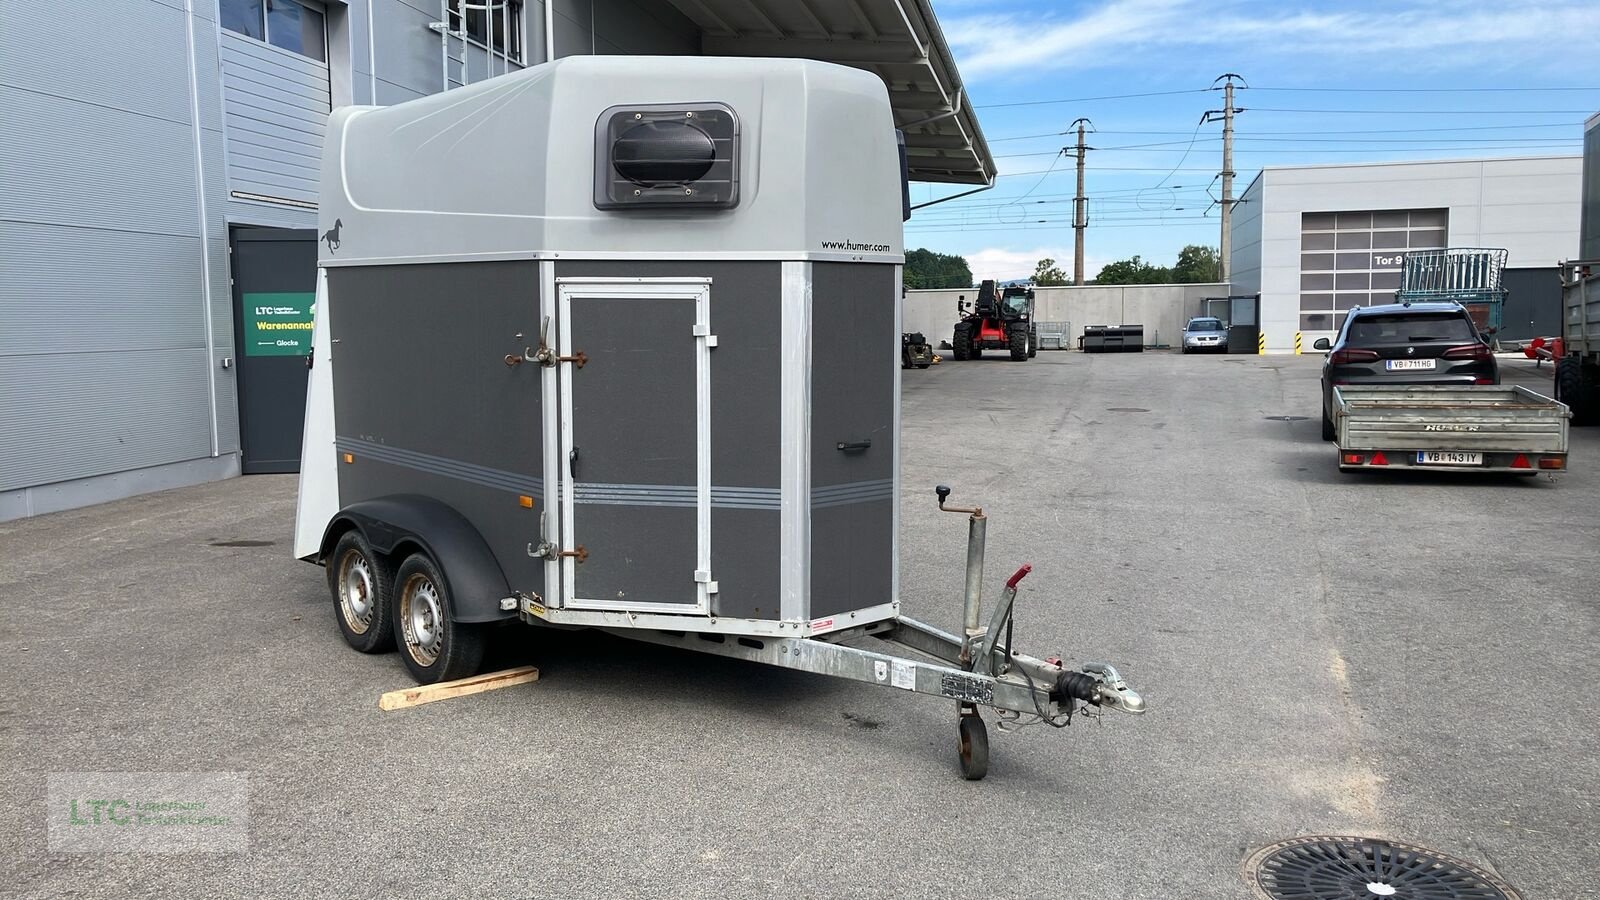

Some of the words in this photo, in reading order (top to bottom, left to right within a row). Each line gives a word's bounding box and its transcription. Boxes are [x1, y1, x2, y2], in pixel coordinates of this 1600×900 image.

[821, 239, 890, 252] www.humer.com
[1374, 256, 1394, 265] Tor
[1395, 255, 1403, 265] 9
[255, 306, 273, 315] LTC
[1428, 452, 1440, 462] VB
